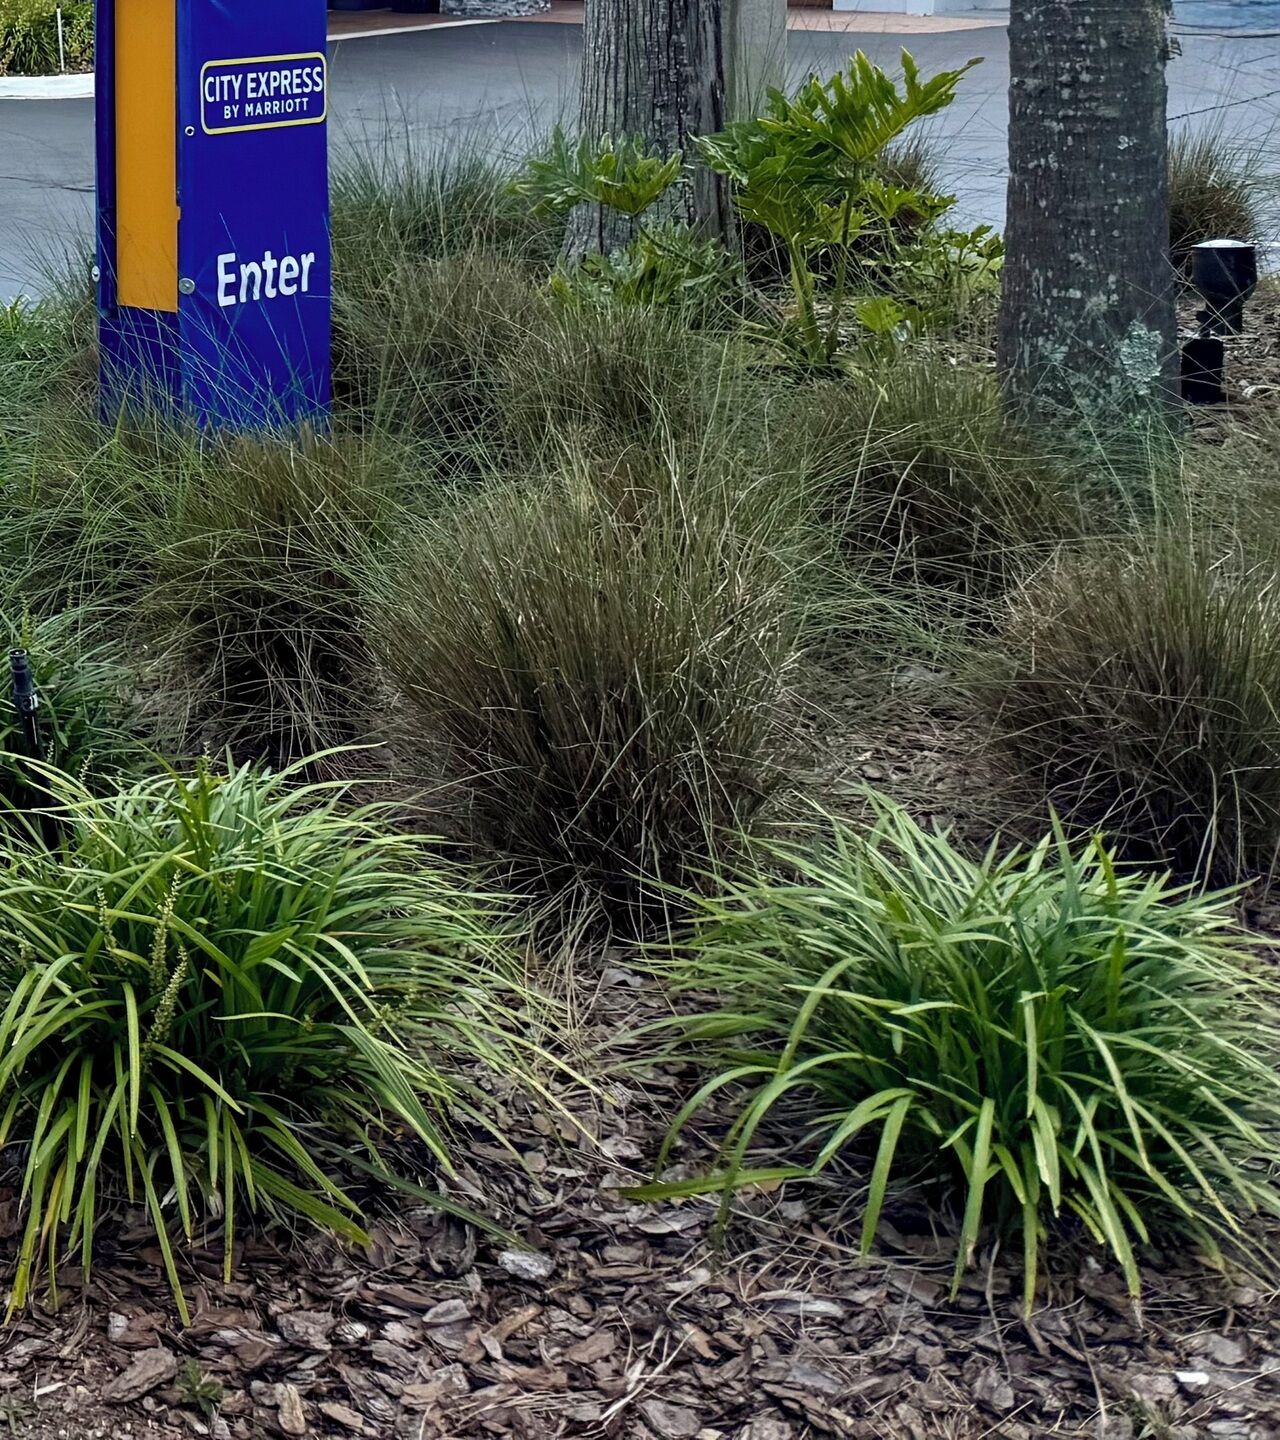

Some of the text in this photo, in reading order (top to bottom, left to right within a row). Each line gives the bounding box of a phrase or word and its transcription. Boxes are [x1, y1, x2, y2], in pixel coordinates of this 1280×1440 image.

[204, 65, 324, 104] CITY EXPRESS
[223, 97, 310, 120] BY MARRIOTT
[215, 249, 316, 308] Enter
